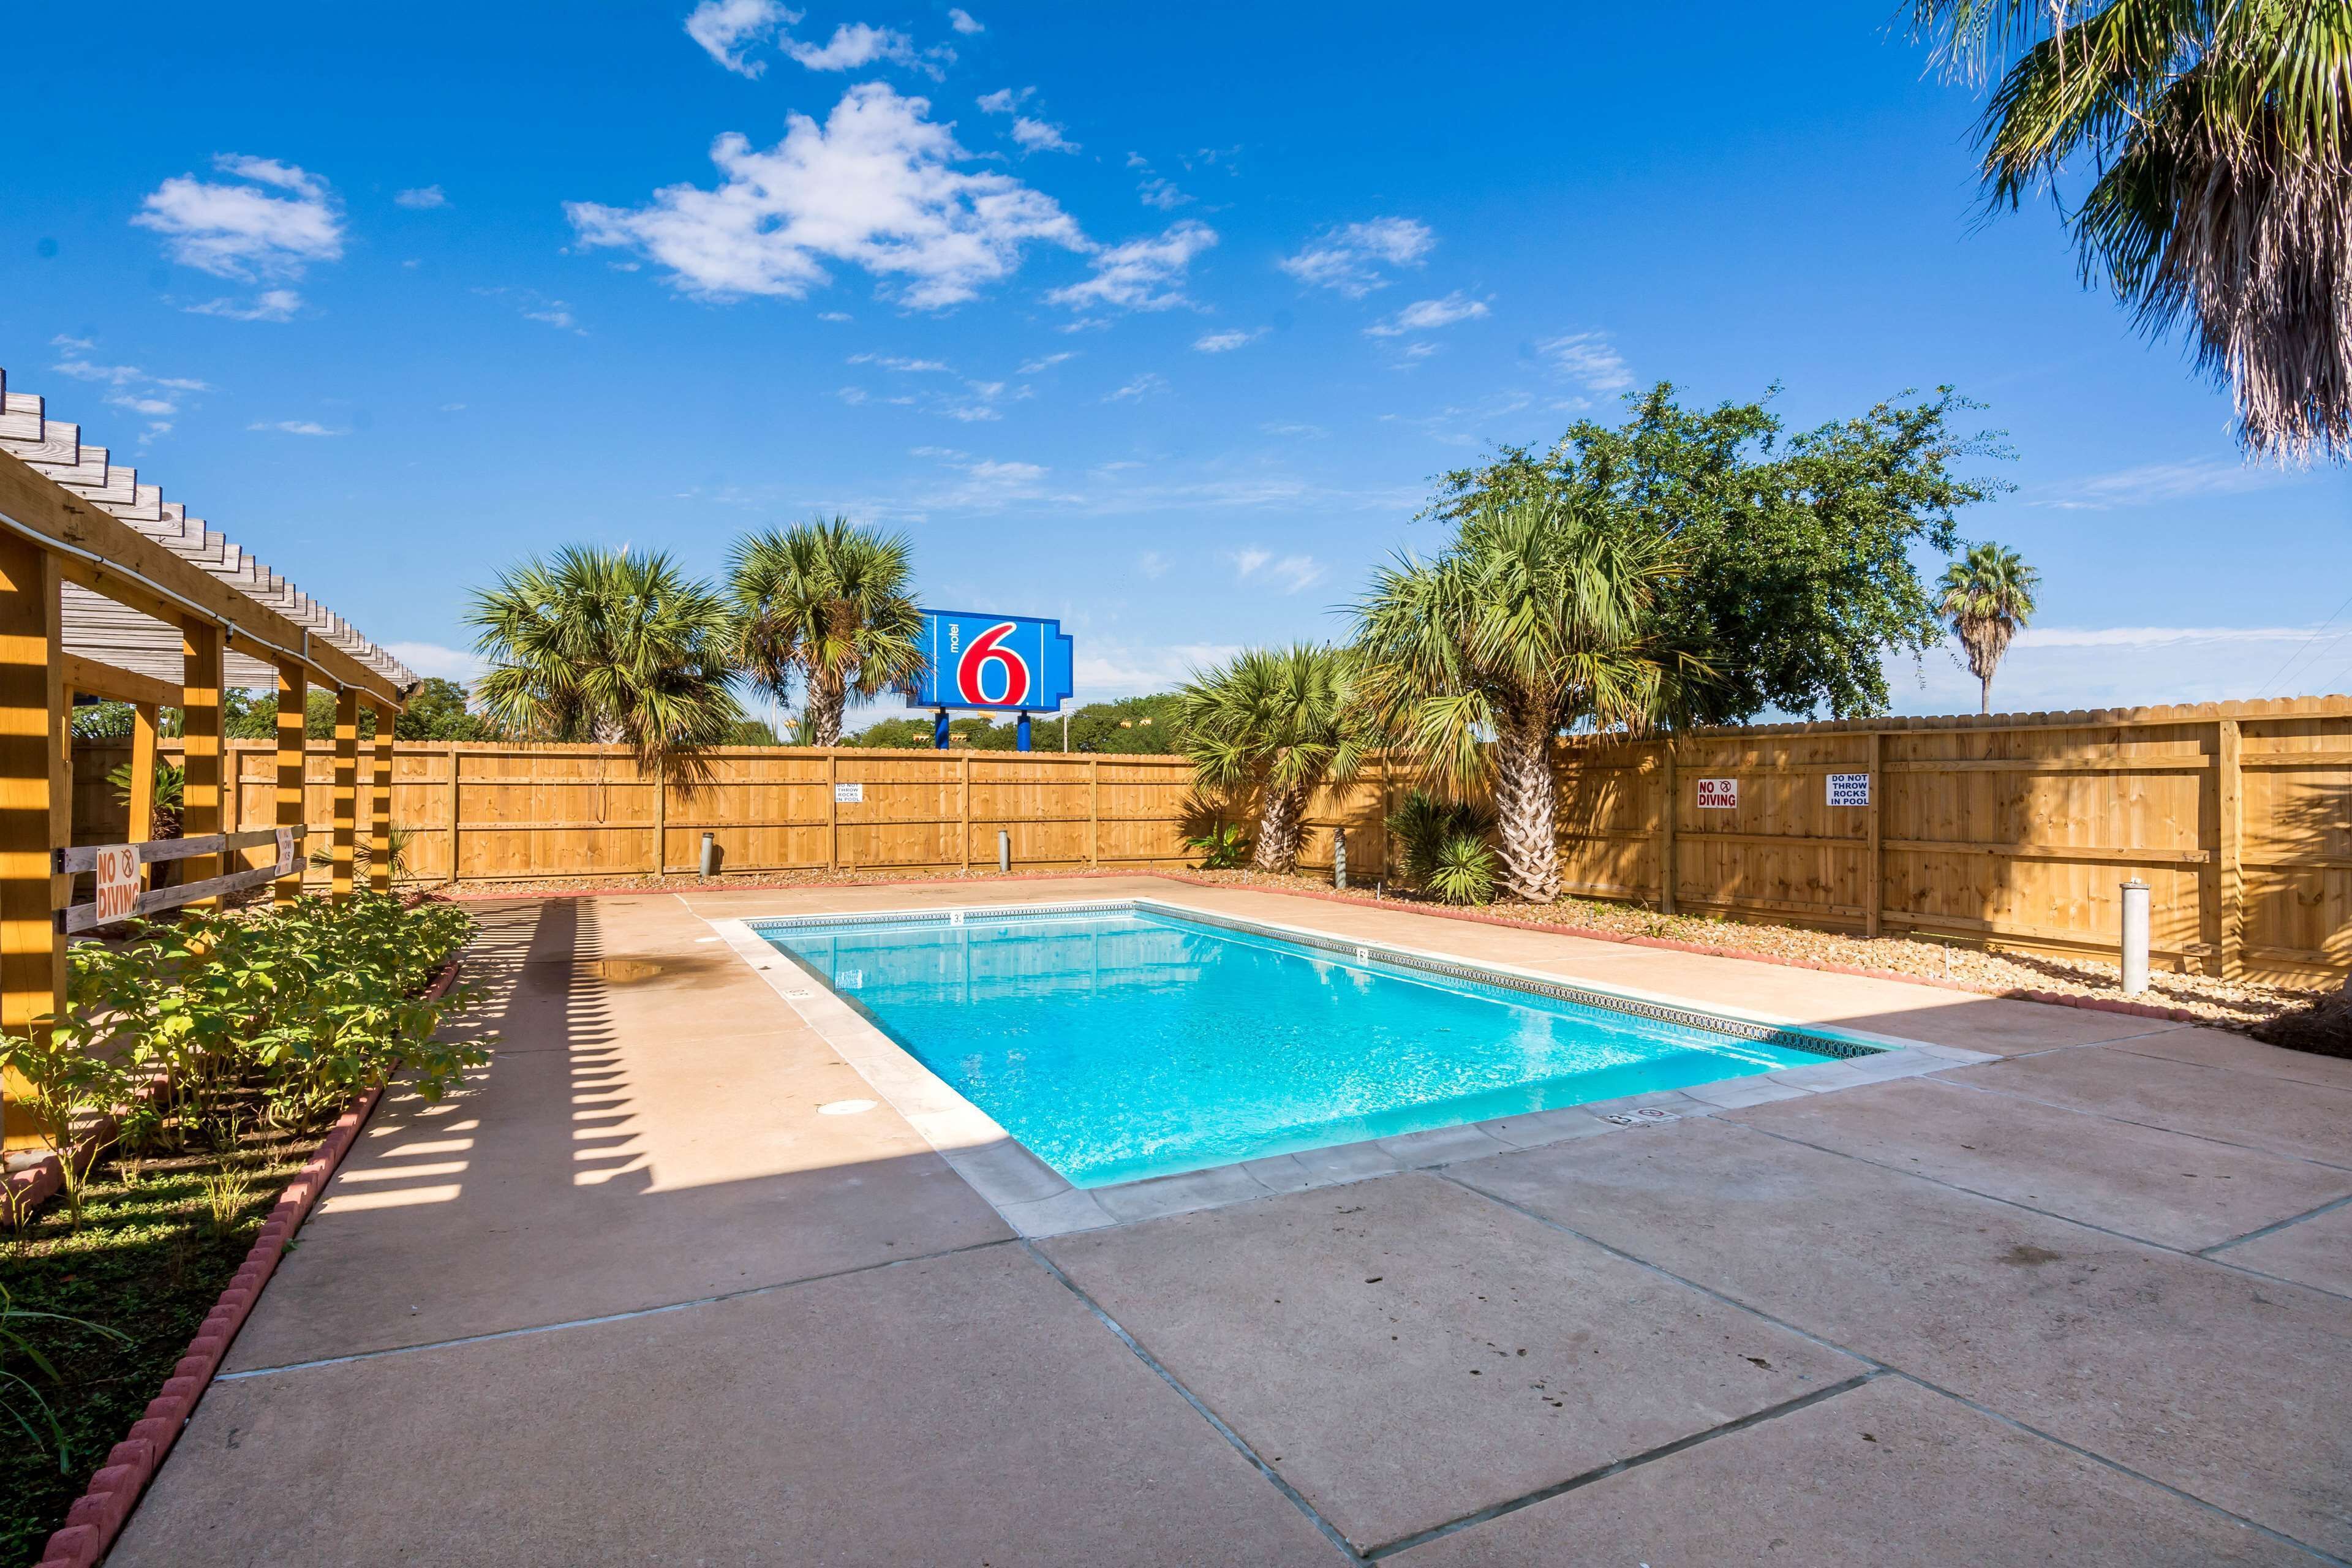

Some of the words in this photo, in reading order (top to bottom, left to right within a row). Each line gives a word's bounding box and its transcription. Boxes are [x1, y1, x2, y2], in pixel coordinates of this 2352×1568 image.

[949, 624, 959, 653] motel
[957, 622, 1030, 706] 6
[1698, 794, 1736, 806] DIVING
[1699, 782, 1714, 793] NO
[98, 852, 116, 884] NO
[98, 882, 139, 919] DIVING
